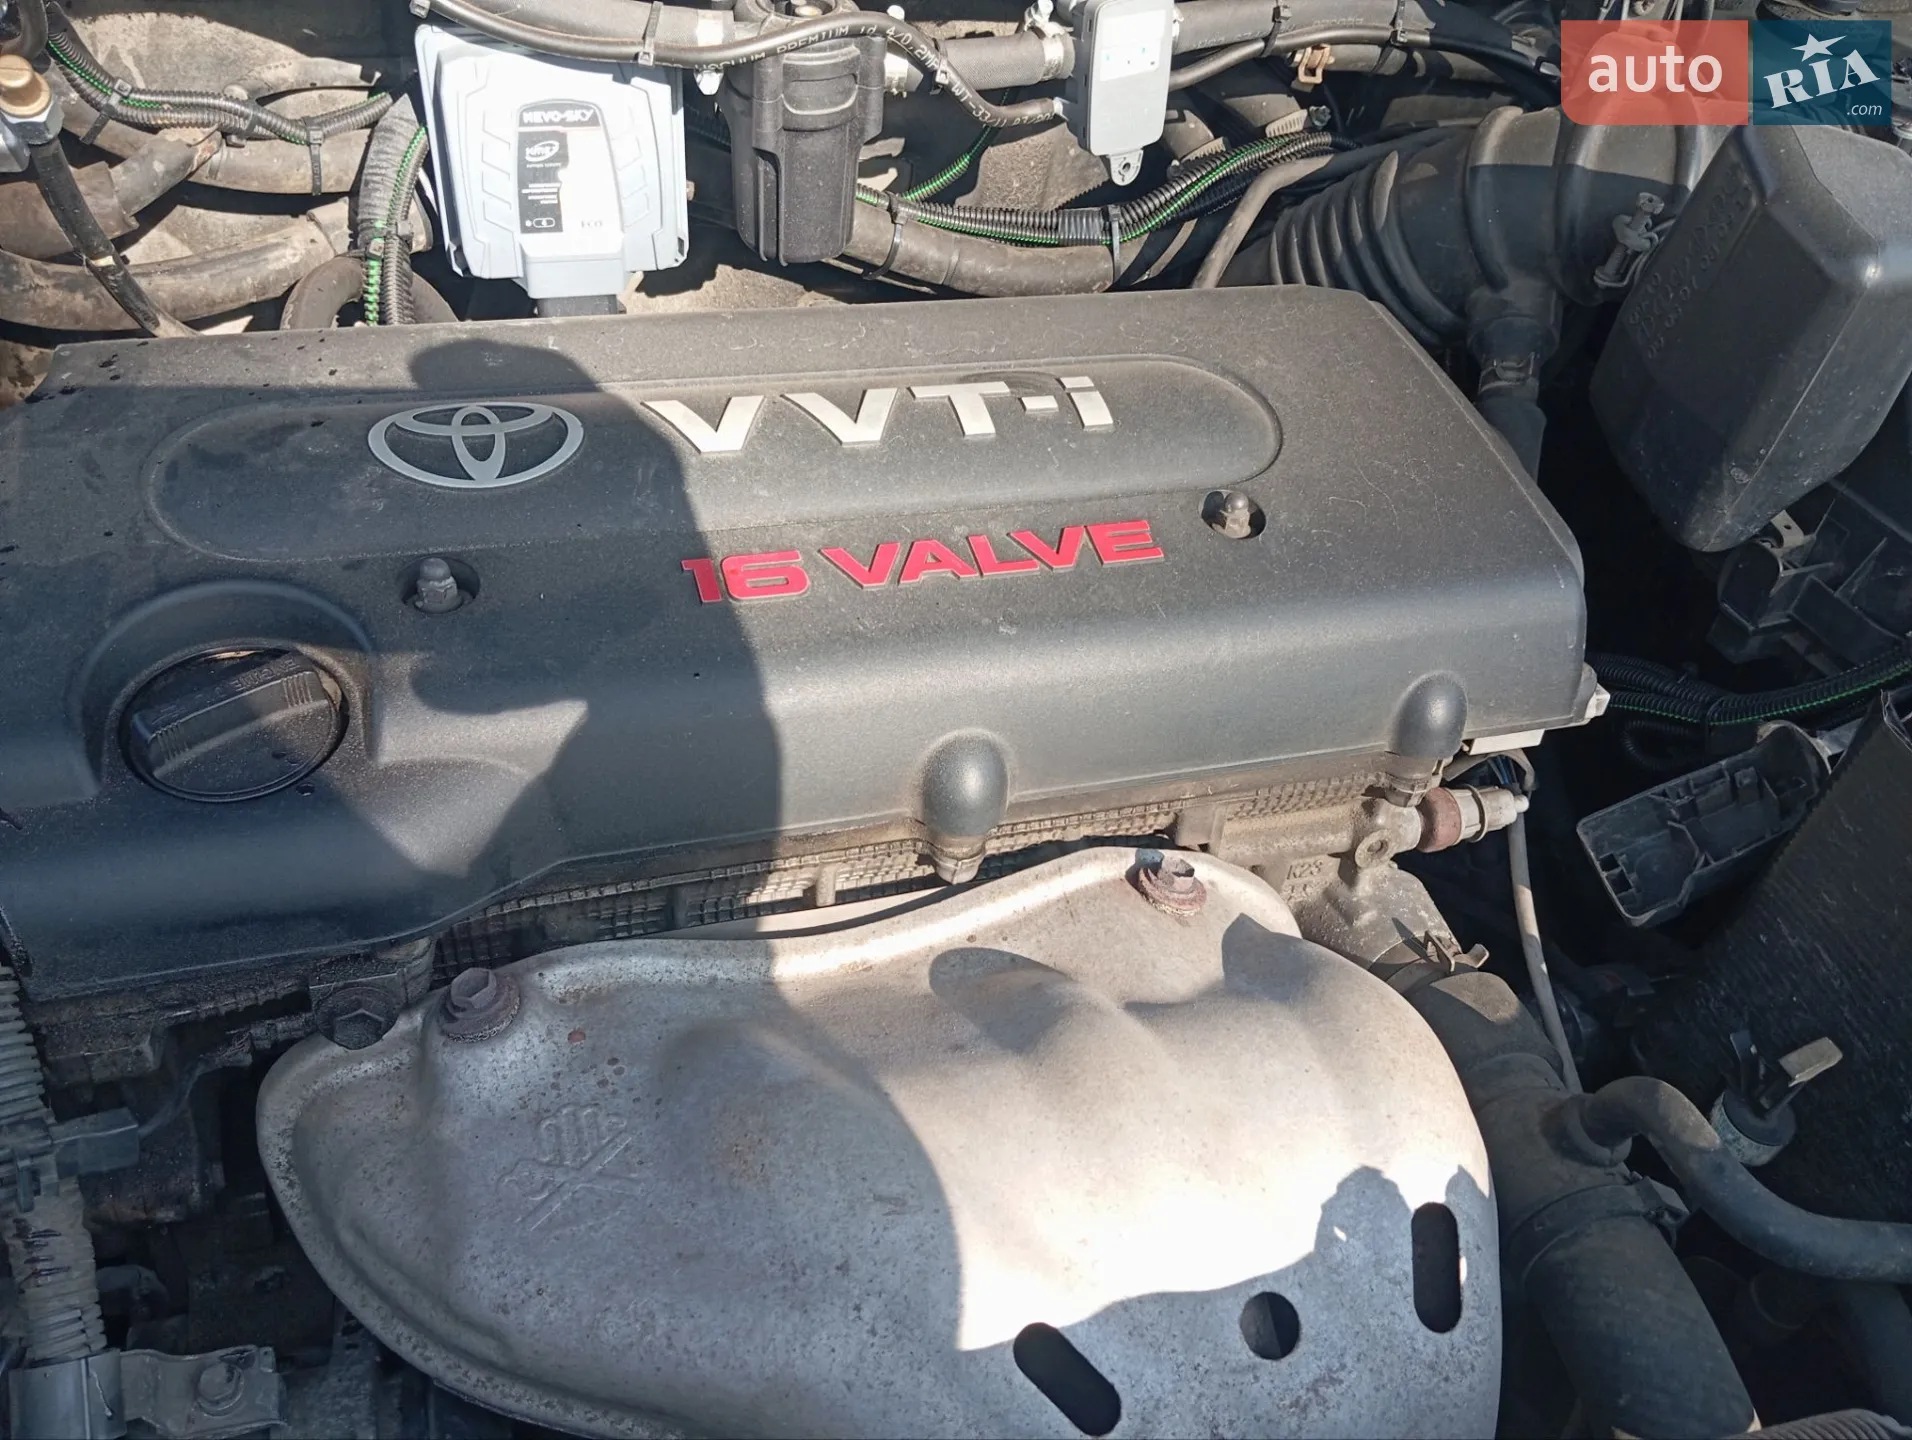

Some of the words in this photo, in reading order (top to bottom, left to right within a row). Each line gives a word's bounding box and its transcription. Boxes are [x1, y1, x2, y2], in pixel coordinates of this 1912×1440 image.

[641, 376, 1114, 453] VVT-i
[682, 550, 811, 603] 16
[819, 520, 1164, 590] VALVE
